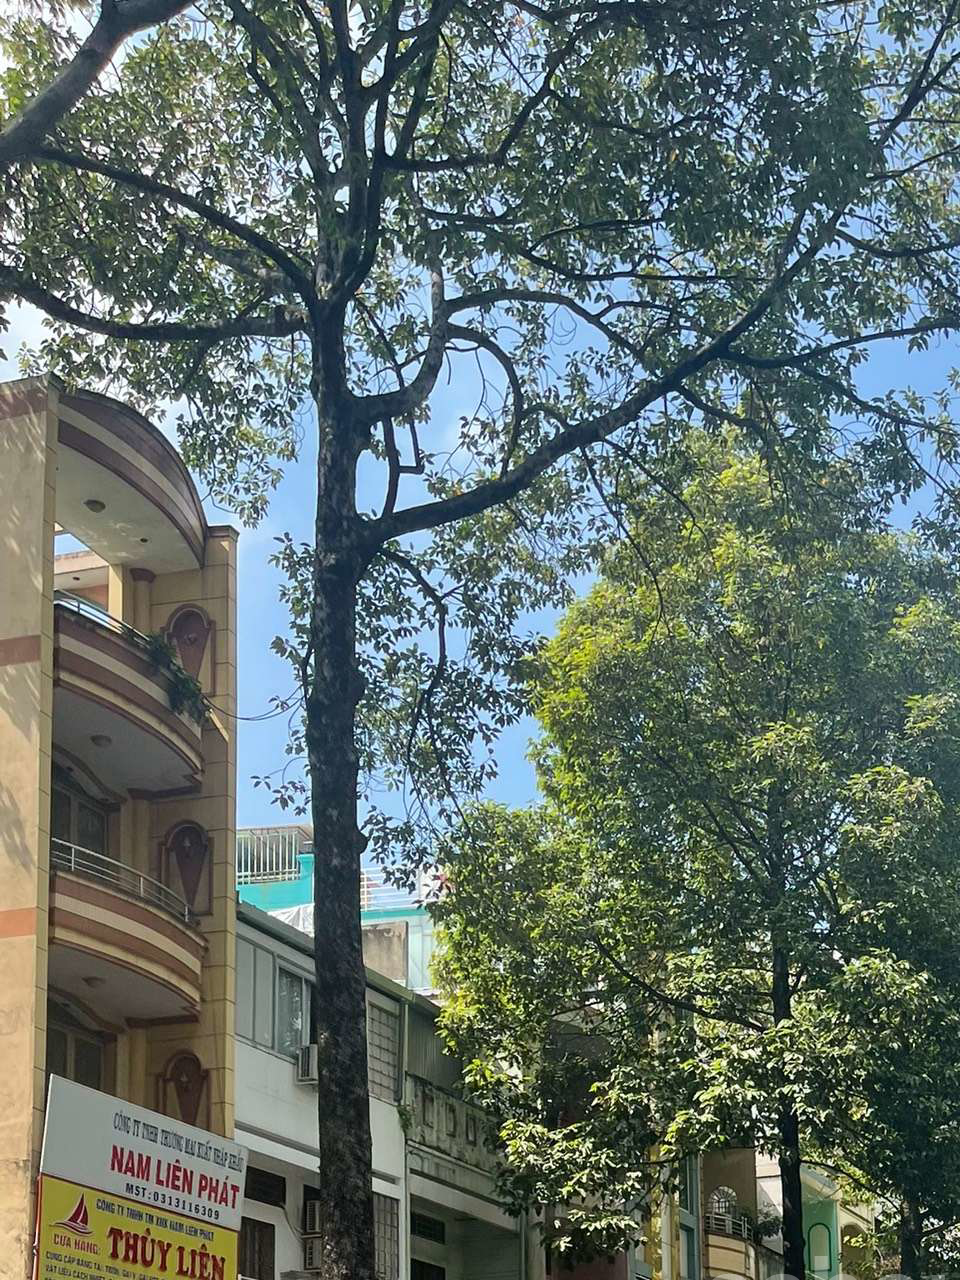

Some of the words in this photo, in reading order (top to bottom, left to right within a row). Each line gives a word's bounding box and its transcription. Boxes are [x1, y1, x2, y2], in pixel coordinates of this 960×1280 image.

[110, 1144, 152, 1182] NAM
[155, 1158, 194, 1195] LIÊN
[197, 1175, 240, 1209] PHÁT
[106, 1226, 172, 1272] THỦY
